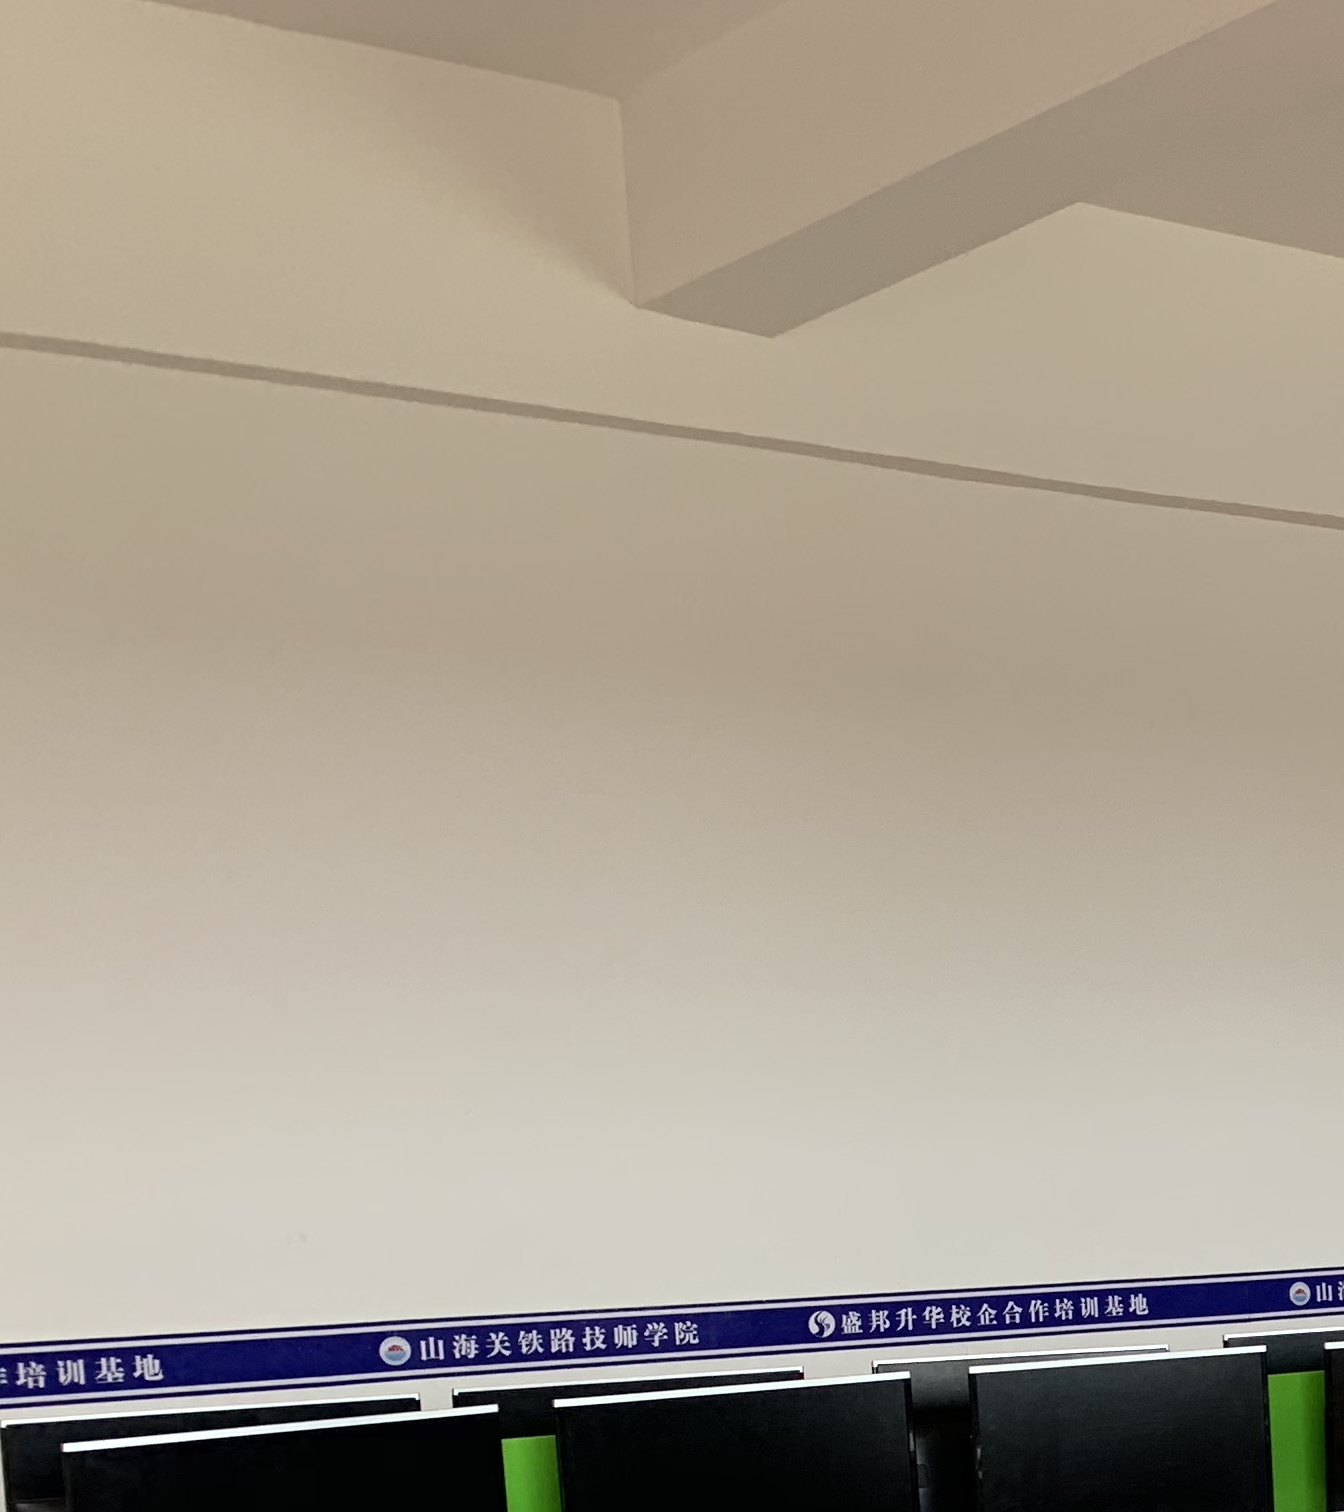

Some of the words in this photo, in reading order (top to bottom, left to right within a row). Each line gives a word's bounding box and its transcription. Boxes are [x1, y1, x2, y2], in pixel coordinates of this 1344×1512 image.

[840, 1293, 1150, 1336] 盛邦升华校企合作培训基地
[419, 1321, 700, 1361] 山海关铁路技师学院
[0, 1354, 164, 1389] 培训基地
